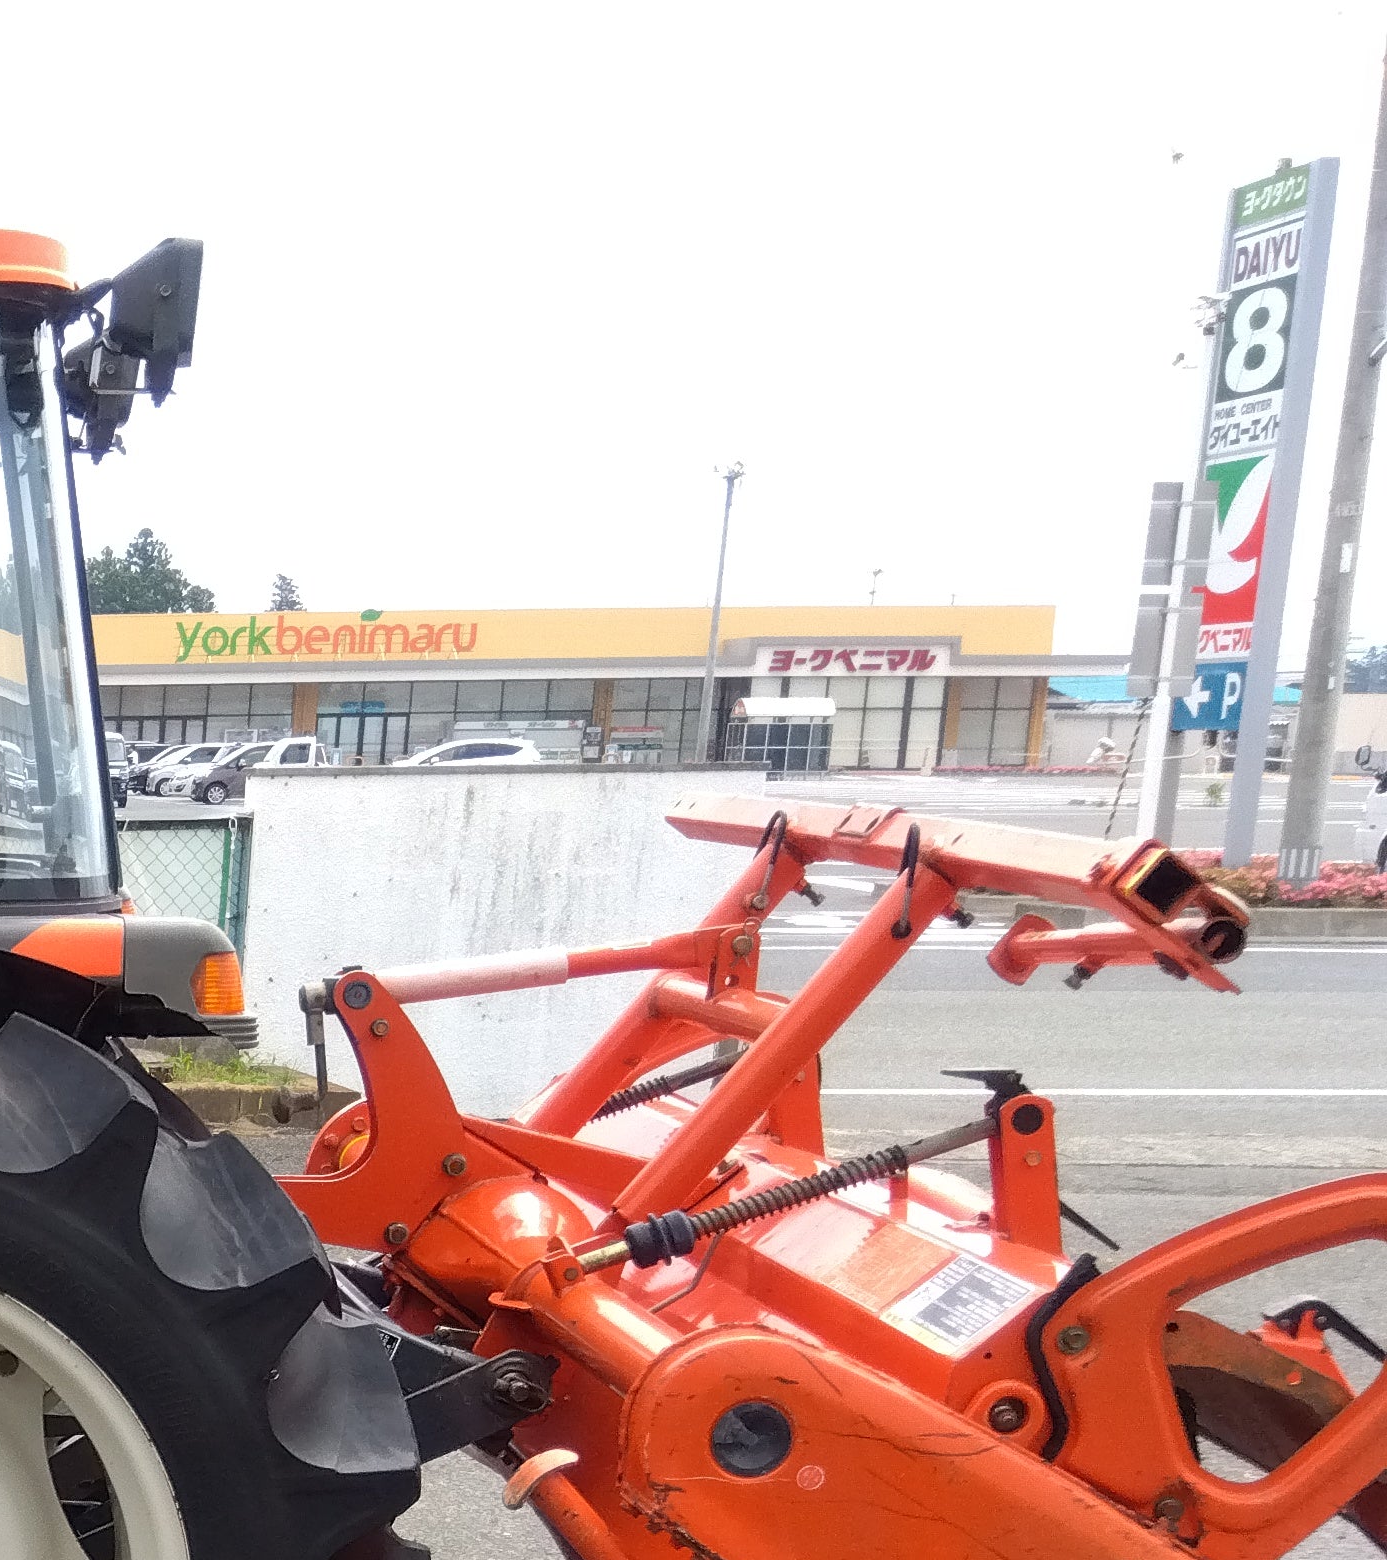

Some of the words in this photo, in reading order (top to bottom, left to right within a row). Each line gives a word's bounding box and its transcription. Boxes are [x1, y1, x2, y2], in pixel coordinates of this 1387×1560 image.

[1242, 175, 1307, 217] ヨークタウン
[1233, 228, 1303, 284] DAIYU
[1223, 286, 1289, 393] 8
[176, 612, 478, 663] yorkbenimaru
[768, 649, 937, 673] ヨークベニマル
[1220, 672, 1242, 720] P
